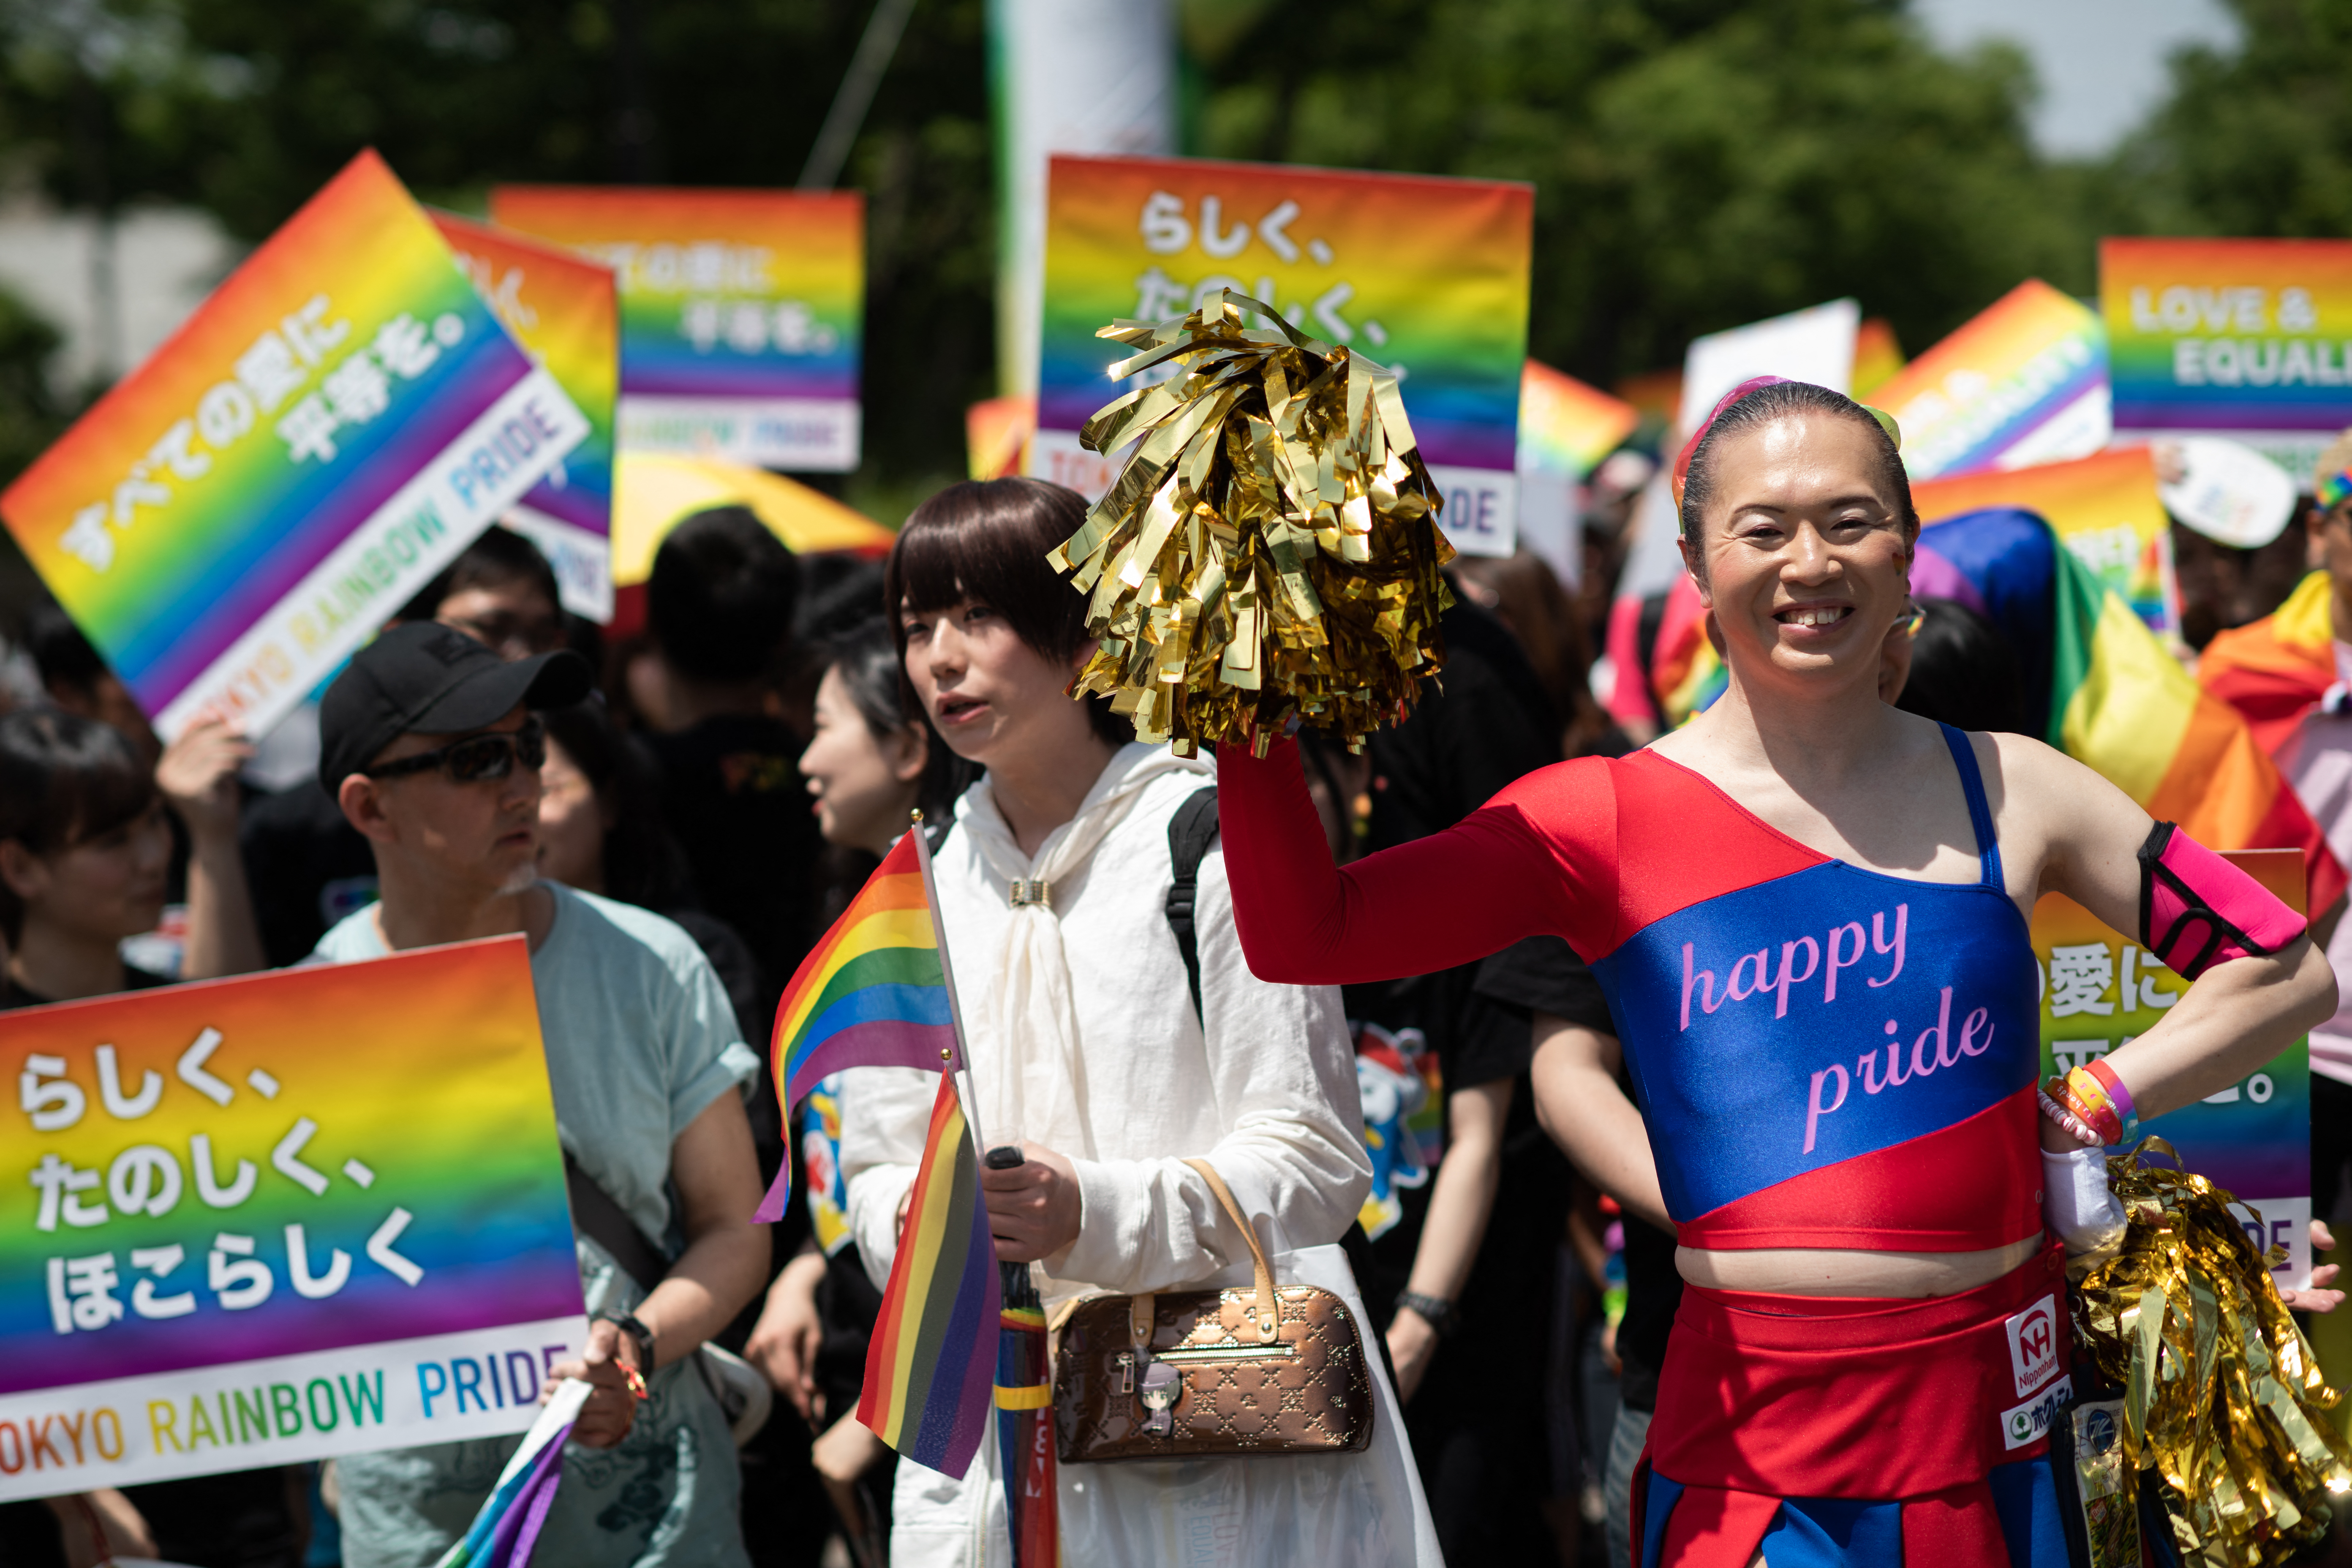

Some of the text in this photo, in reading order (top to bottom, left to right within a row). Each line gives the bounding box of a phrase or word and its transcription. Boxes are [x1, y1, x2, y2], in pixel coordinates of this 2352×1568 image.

[1139, 189, 1334, 264] らしく、
[2128, 285, 2318, 335] LOVE &
[58, 293, 352, 574] すべての愛に
[274, 312, 466, 463] 平等を。
[287, 494, 448, 658] RAINBOW
[448, 395, 561, 511] PRIDE
[1680, 902, 1909, 1032] happy
[2037, 941, 2179, 1018] 愛に
[18, 1026, 280, 1132] らしく、
[1802, 985, 1995, 1156] pride
[2056, 1085, 2083, 1109] hands
[30, 1115, 376, 1233] たのしく、
[46, 1206, 425, 1335] ほこらしく
[146, 1368, 386, 1456] RAINBOW
[2018, 1354, 2057, 1390] Nipponham
